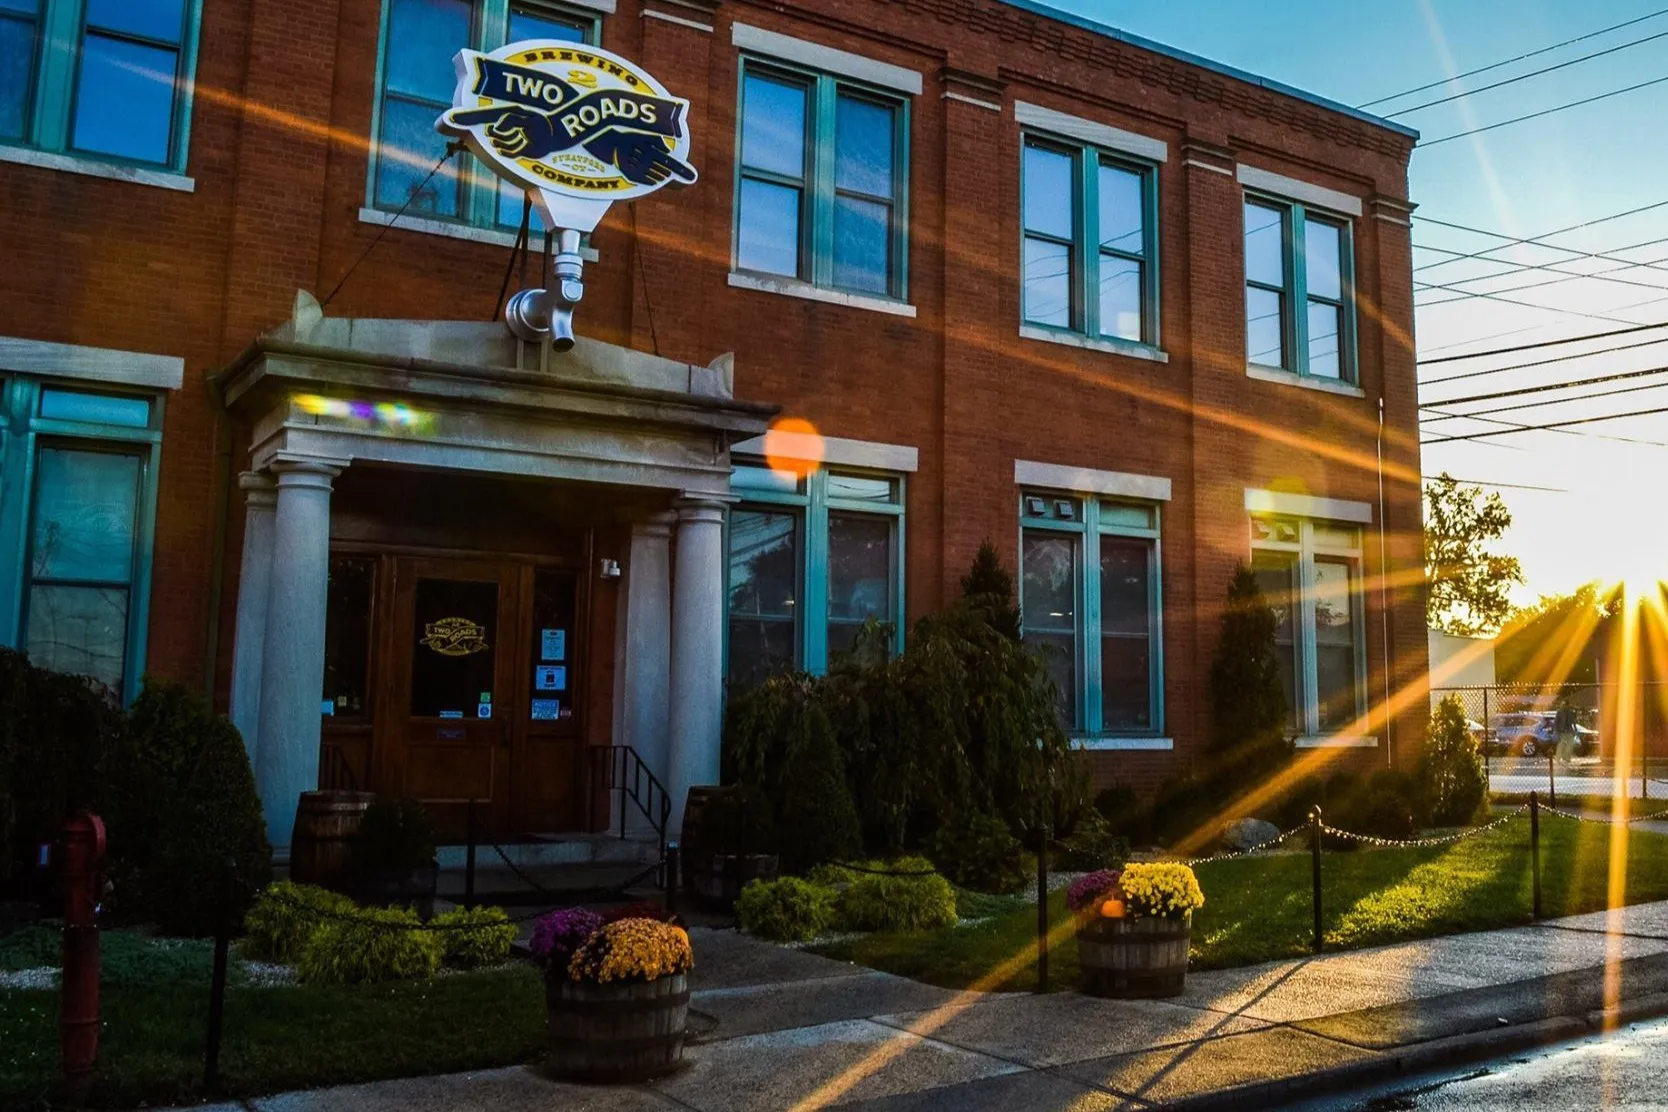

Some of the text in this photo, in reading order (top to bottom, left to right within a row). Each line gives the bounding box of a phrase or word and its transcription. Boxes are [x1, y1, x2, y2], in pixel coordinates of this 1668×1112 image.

[524, 50, 638, 86] BREWING
[502, 71, 657, 138] TWO ROADS
[531, 163, 620, 190] COMPANY
[433, 627, 478, 643] TWO ROADS
